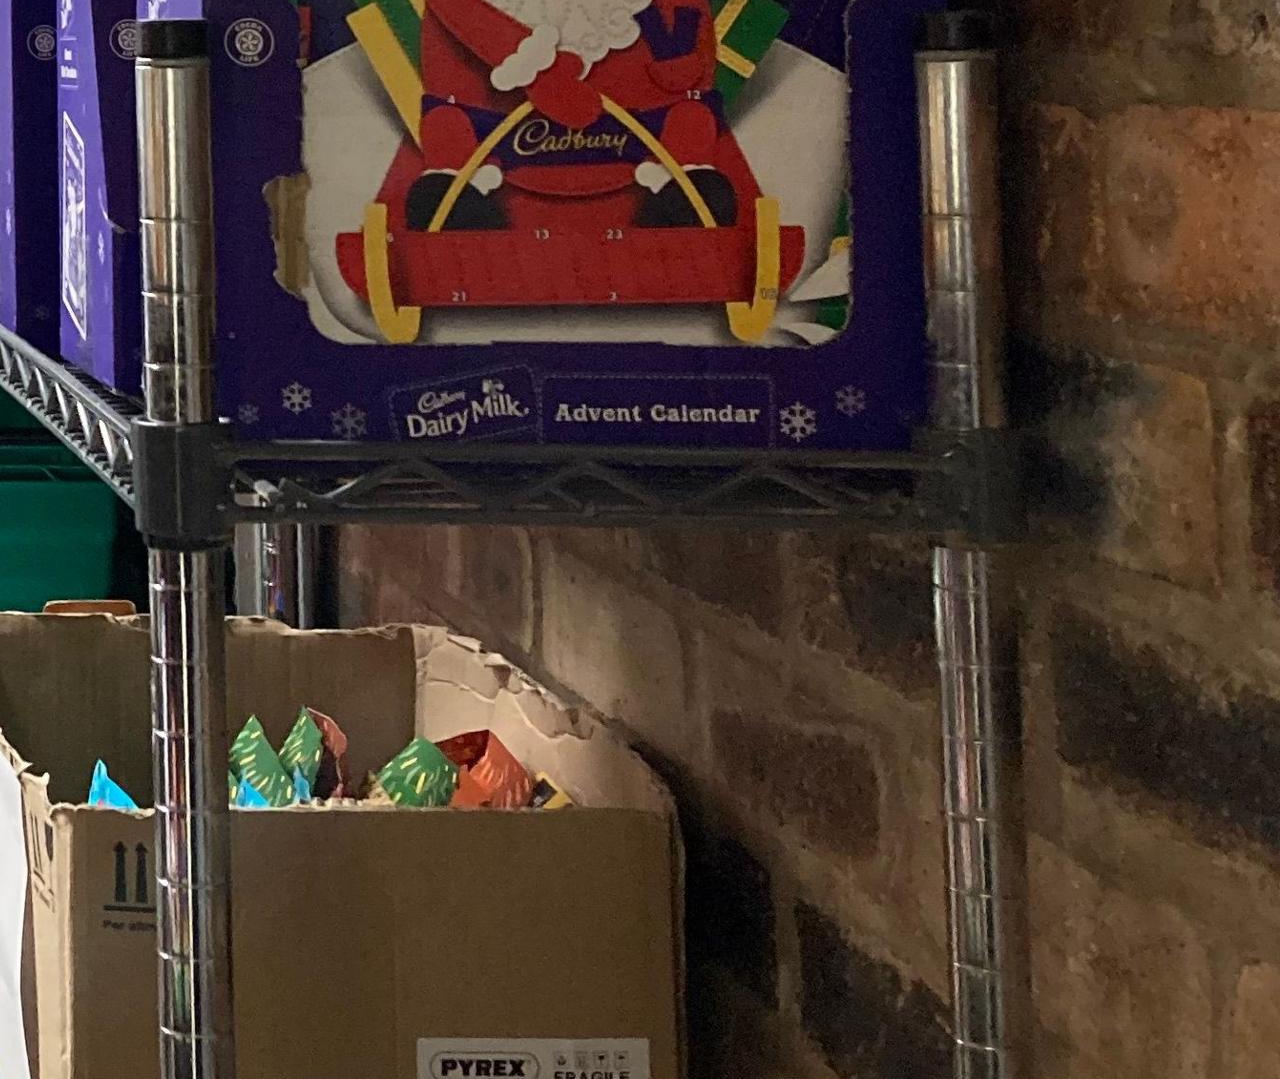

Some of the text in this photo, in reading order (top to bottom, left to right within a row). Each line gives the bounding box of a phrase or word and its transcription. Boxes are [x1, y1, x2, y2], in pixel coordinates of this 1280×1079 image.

[513, 118, 630, 156] Cadbury
[406, 408, 470, 440] Dairy
[556, 403, 761, 424] Advent Calendar
[440, 1058, 527, 1078] PYREX
